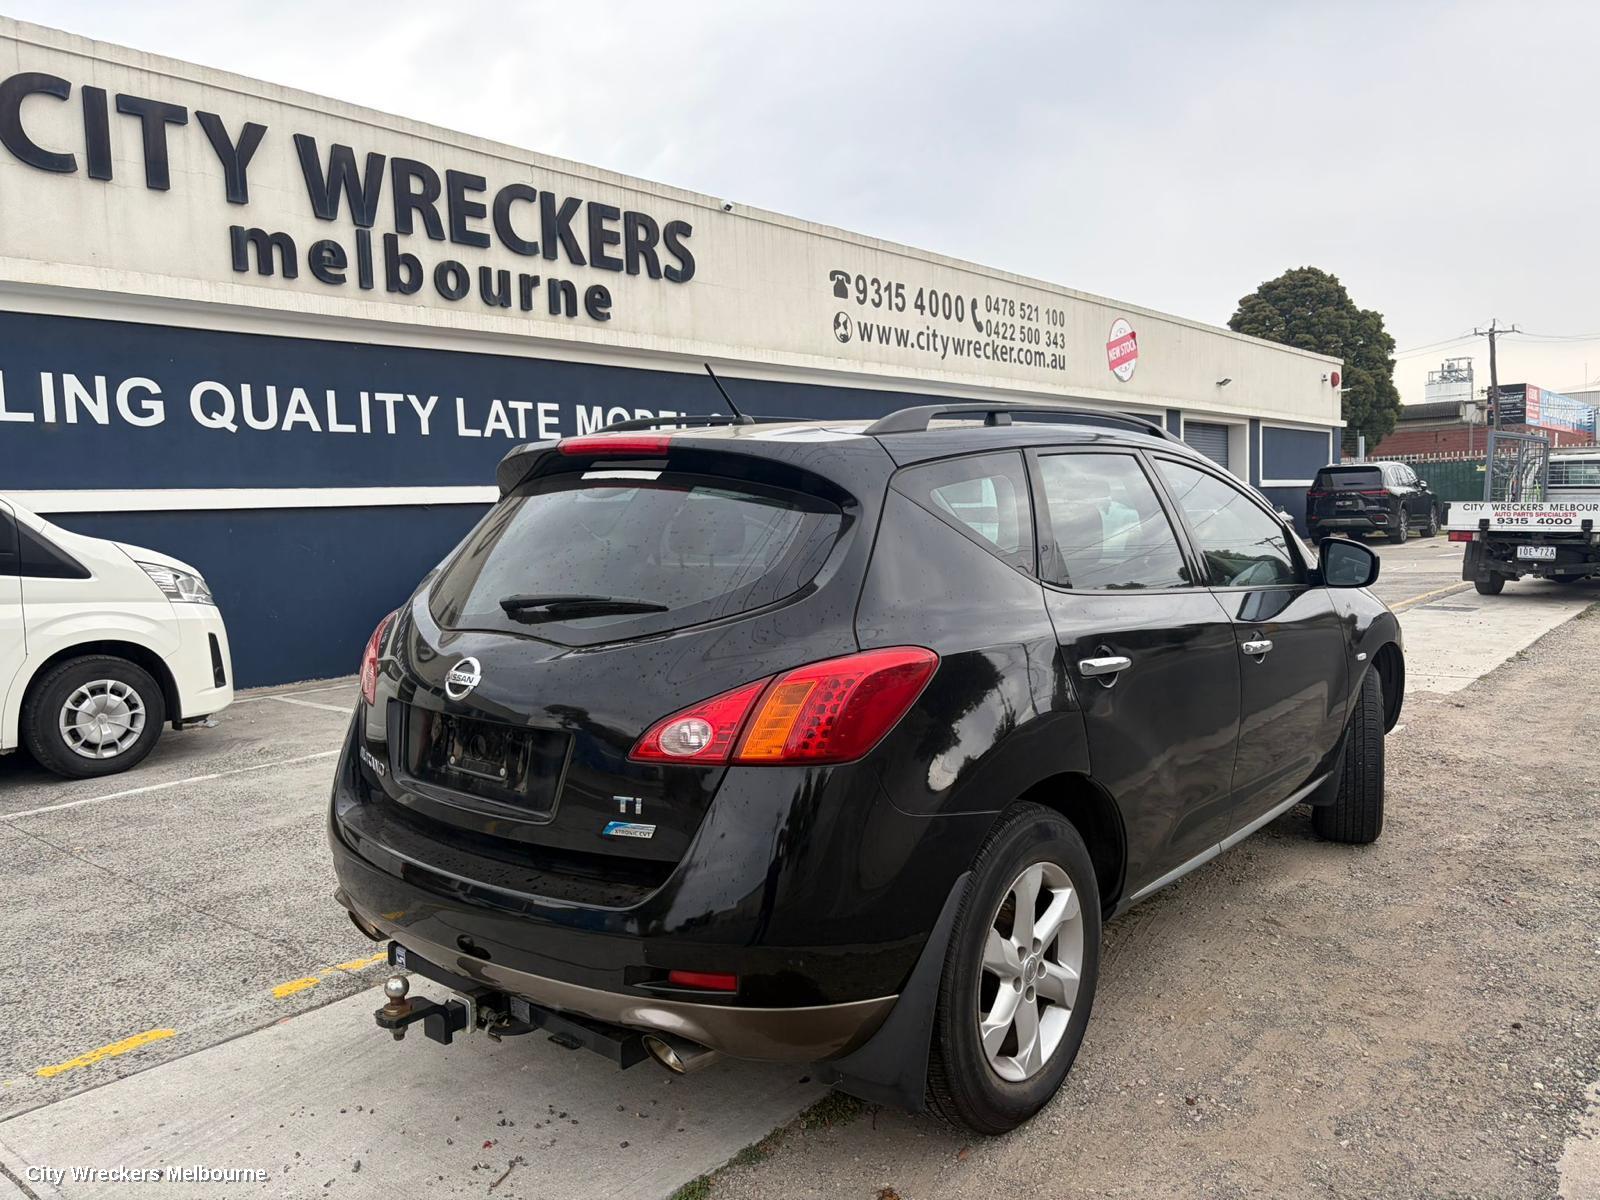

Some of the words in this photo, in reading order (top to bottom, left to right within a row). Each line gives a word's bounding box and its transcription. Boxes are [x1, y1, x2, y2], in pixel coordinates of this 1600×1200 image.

[0, 72, 268, 206] CITY
[292, 133, 696, 284] WRECKERS
[230, 225, 612, 322] melbourne
[855, 274, 906, 313] 9315
[914, 287, 965, 323] 4000
[985, 294, 1015, 317] 0478
[1019, 302, 1039, 322] 521
[1045, 308, 1065, 327] 100
[857, 321, 1066, 371] www.citywrecker.com.au
[985, 319, 1016, 341] 0422
[1019, 325, 1040, 345] 500
[1045, 330, 1066, 349] 343
[0, 371, 166, 427] LING
[190, 381, 439, 435] QUALITY
[456, 398, 561, 440] LATE
[1462, 503, 1485, 511] CITY
[1491, 503, 1544, 511] WRECKERS
[1549, 503, 1599, 512] MELBOUR
[1496, 517, 1529, 525] 9315
[1536, 517, 1573, 525] 4000
